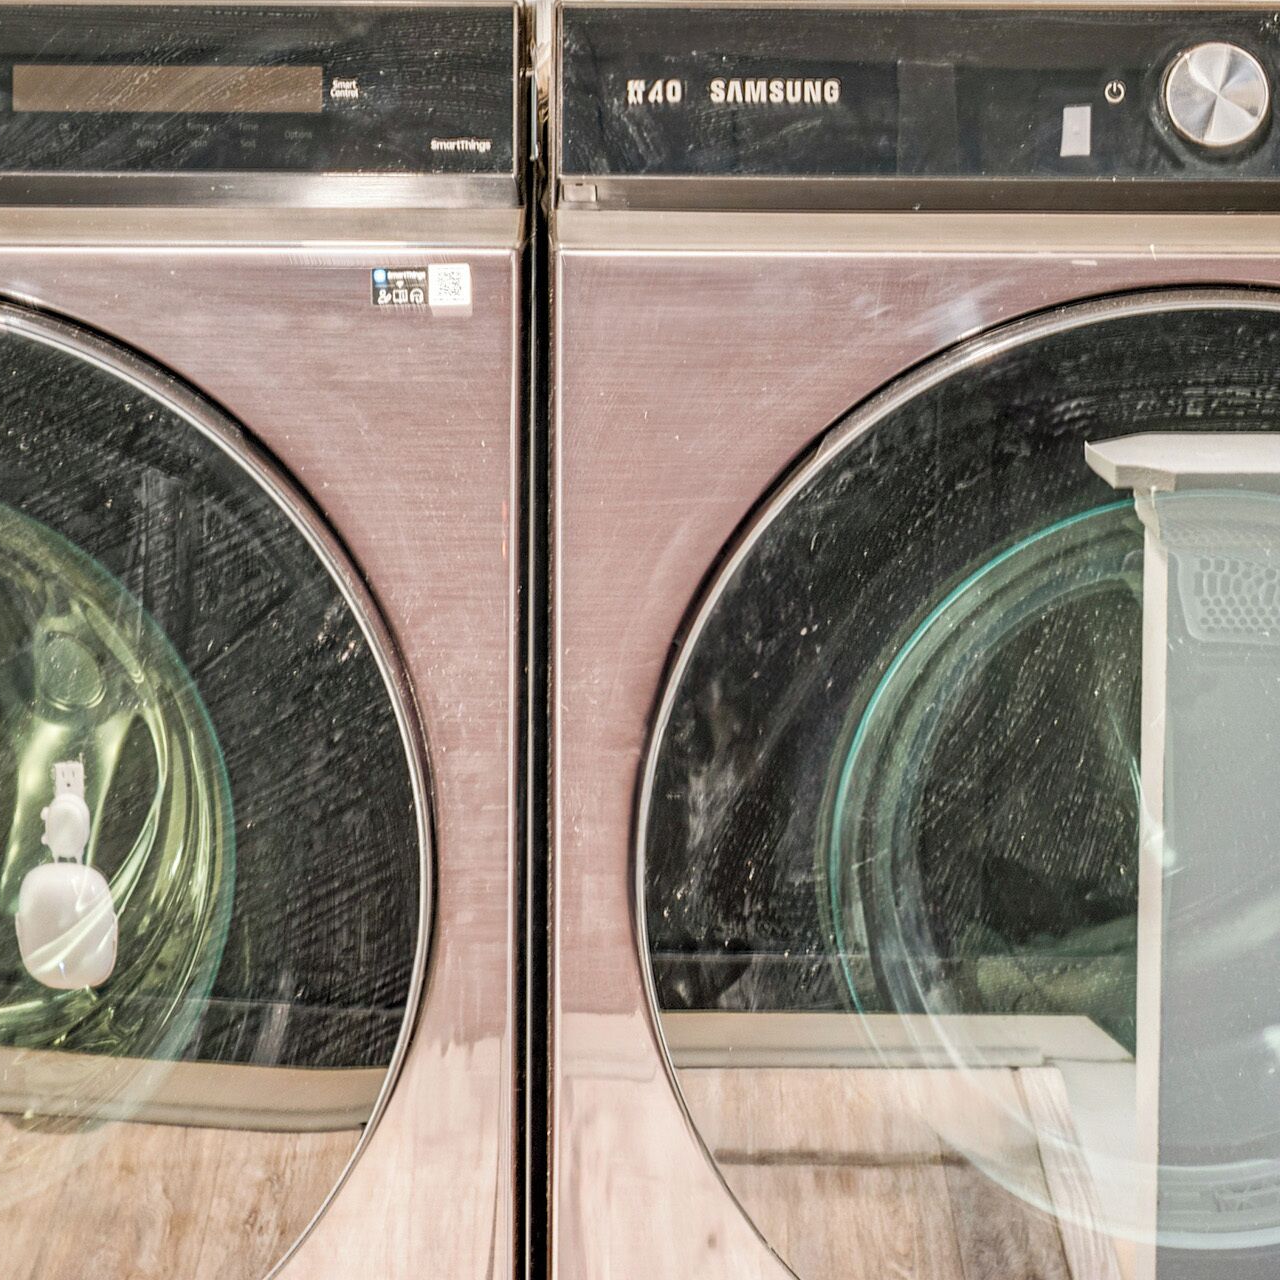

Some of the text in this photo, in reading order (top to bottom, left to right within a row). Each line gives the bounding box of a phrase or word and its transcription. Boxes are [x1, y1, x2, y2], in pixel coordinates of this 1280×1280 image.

[332, 78, 358, 89] Smart
[330, 89, 359, 99] Control
[710, 79, 841, 103] SAMSUNG
[430, 138, 491, 152] SmartThings
